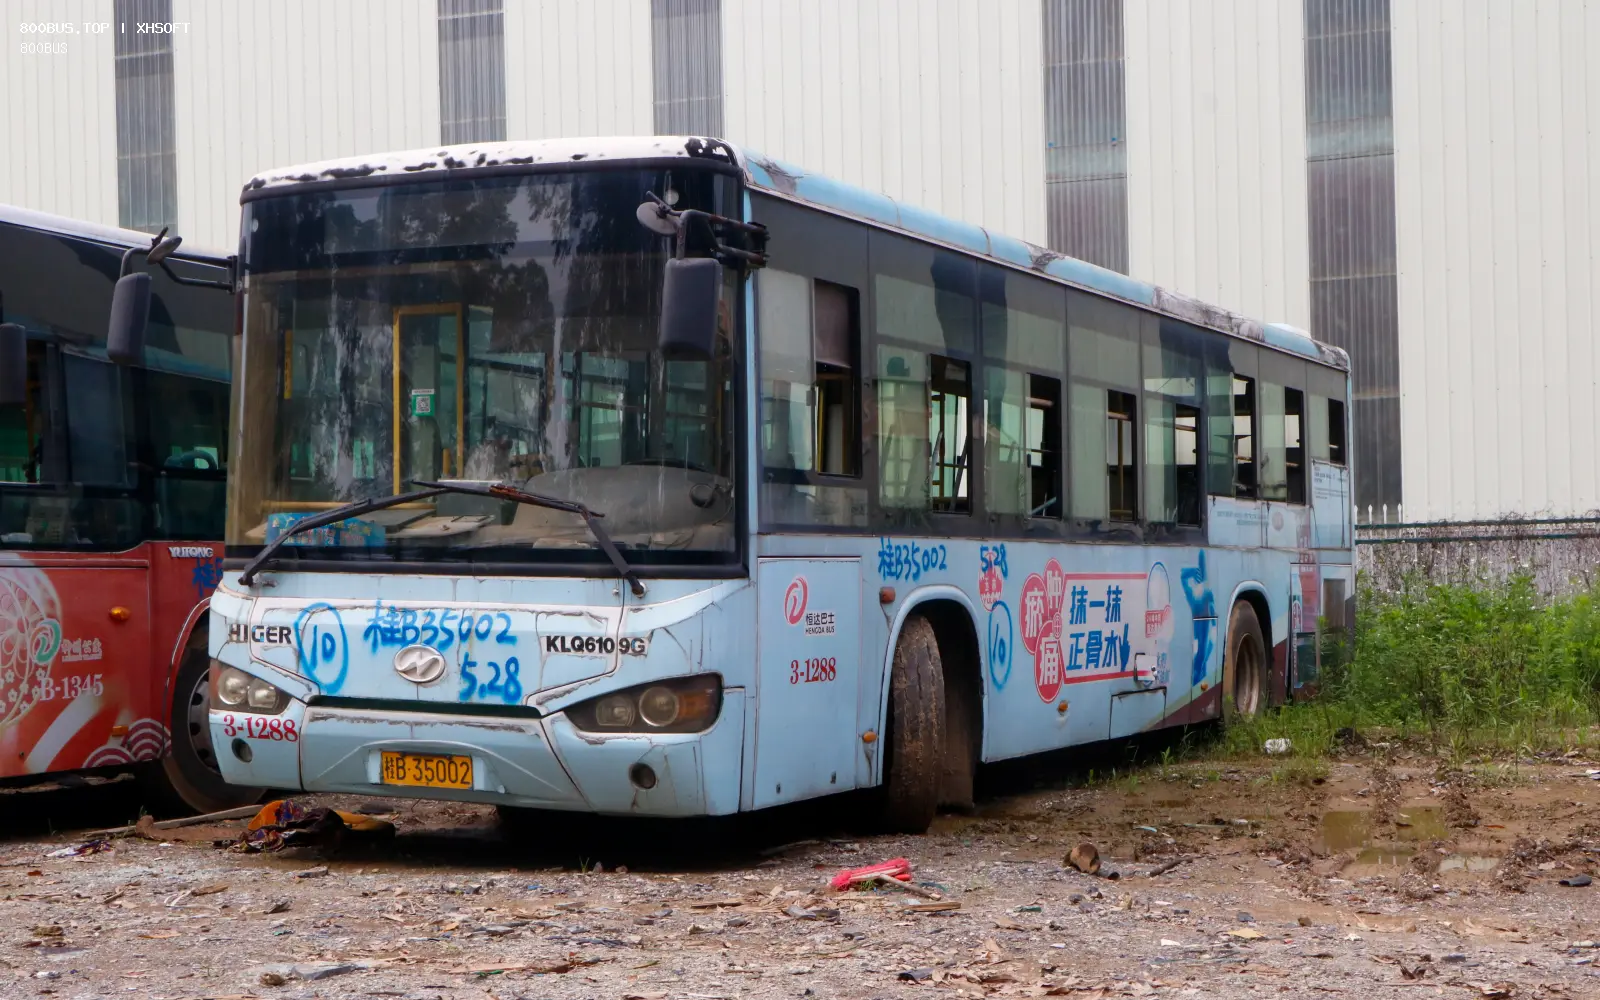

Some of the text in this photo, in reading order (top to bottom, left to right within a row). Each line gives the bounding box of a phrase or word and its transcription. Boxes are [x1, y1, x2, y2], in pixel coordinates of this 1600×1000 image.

[168, 546, 214, 558] YUTONG
[878, 536, 947, 582] 桂B35002
[1046, 570, 1062, 609] 肿
[1069, 585, 1123, 625] 抹一抹
[363, 598, 518, 655] 桂B35002
[805, 612, 835, 626] 恒达巴士
[1024, 587, 1044, 638] 瘀
[228, 623, 292, 645] HIGER
[546, 635, 647, 654] KLQ6109G
[805, 627, 825, 635] HENGDA
[1039, 632, 1059, 686] 痛
[1066, 629, 1118, 671] 正骨水
[39, 673, 104, 701] B-1345
[458, 652, 523, 703] 5.28
[790, 657, 837, 685] 3-1288
[223, 714, 299, 743] 3-1288
